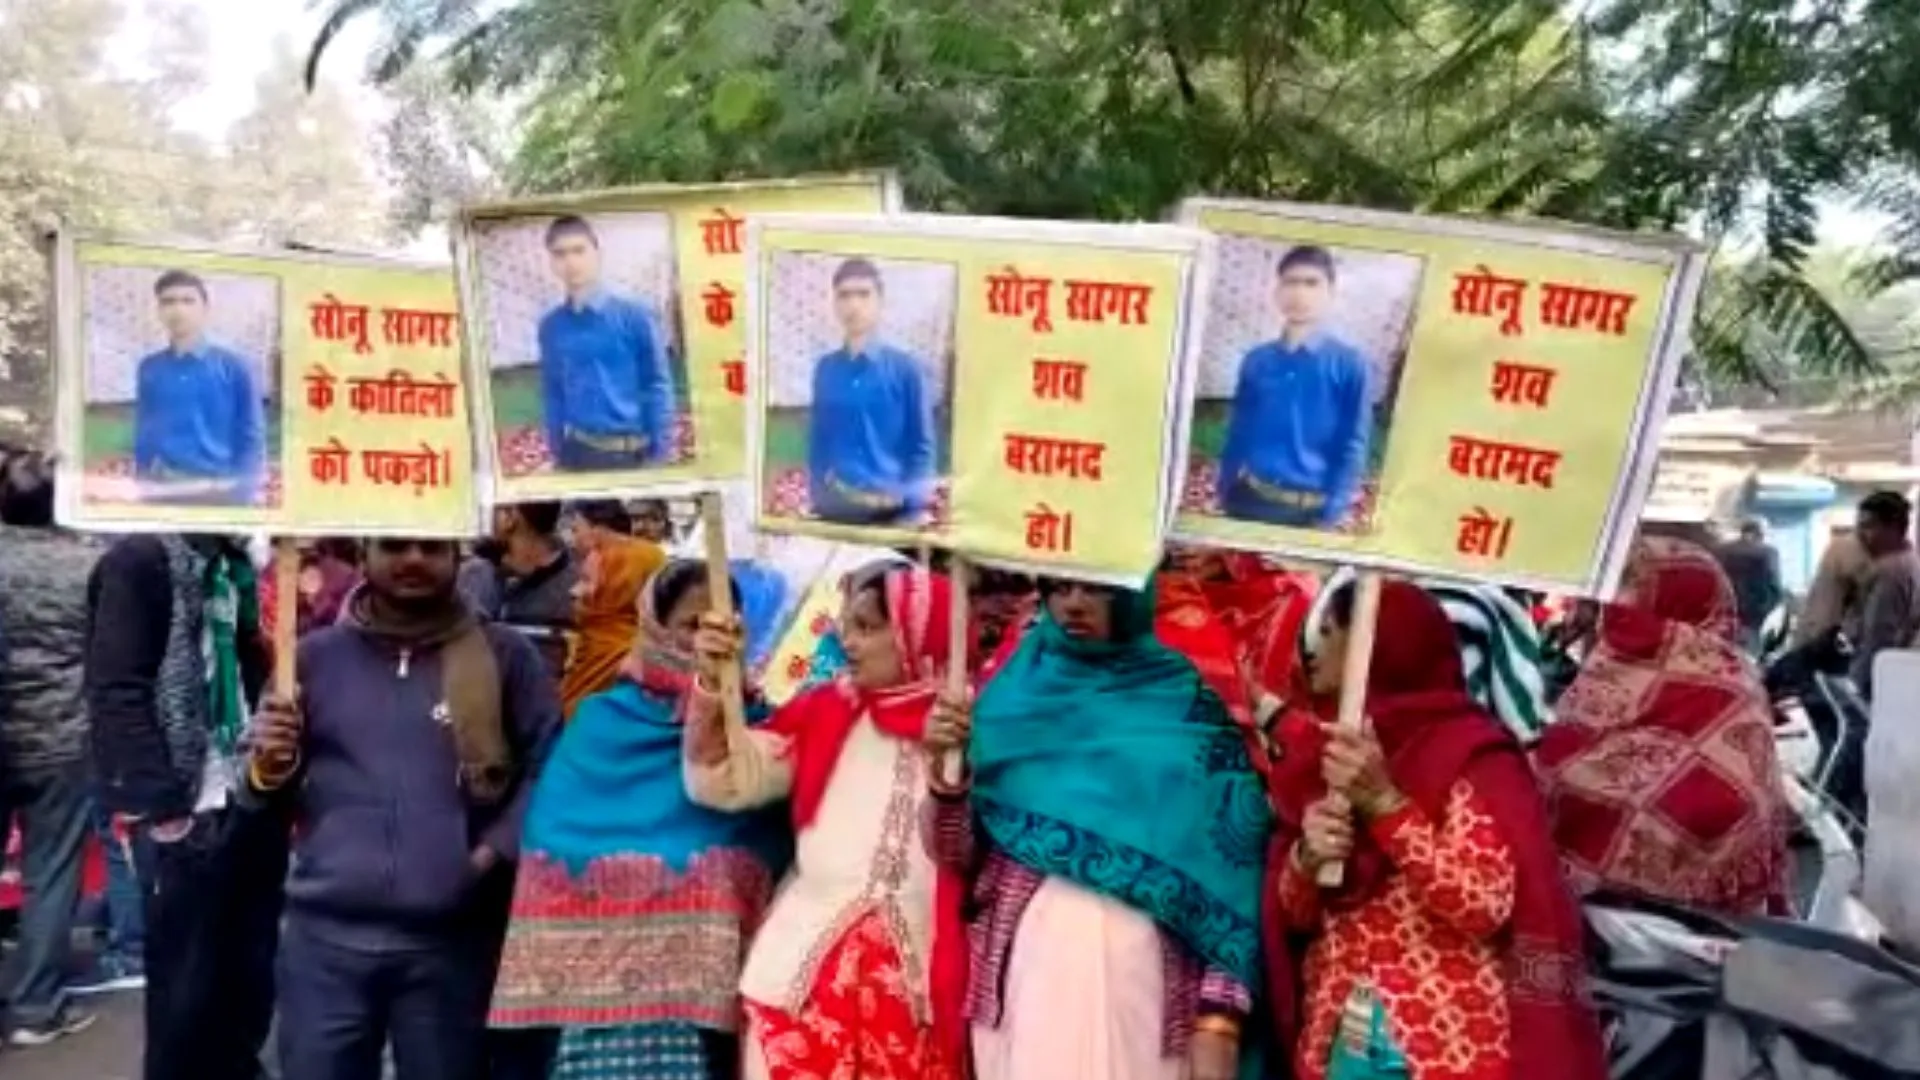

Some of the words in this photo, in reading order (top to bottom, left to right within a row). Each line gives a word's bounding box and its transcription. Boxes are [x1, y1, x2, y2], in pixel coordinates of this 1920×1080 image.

[699, 208, 745, 256] सो
[309, 294, 373, 353] सोनू
[381, 308, 459, 348] सागर
[701, 281, 735, 328] के
[985, 264, 1053, 333] सोनू
[1063, 279, 1153, 325] सागर
[1452, 264, 1527, 336] सोनू
[1539, 281, 1637, 335] सागर
[304, 365, 337, 415] के
[346, 370, 456, 418] कातिलो
[1032, 359, 1087, 402] शव
[1490, 360, 1558, 408] शव
[308, 438, 351, 486] को
[1004, 433, 1105, 482] बरामद
[1448, 434, 1562, 489] बरामद
[1024, 501, 1072, 552] हो।
[1457, 505, 1513, 560] हो।
